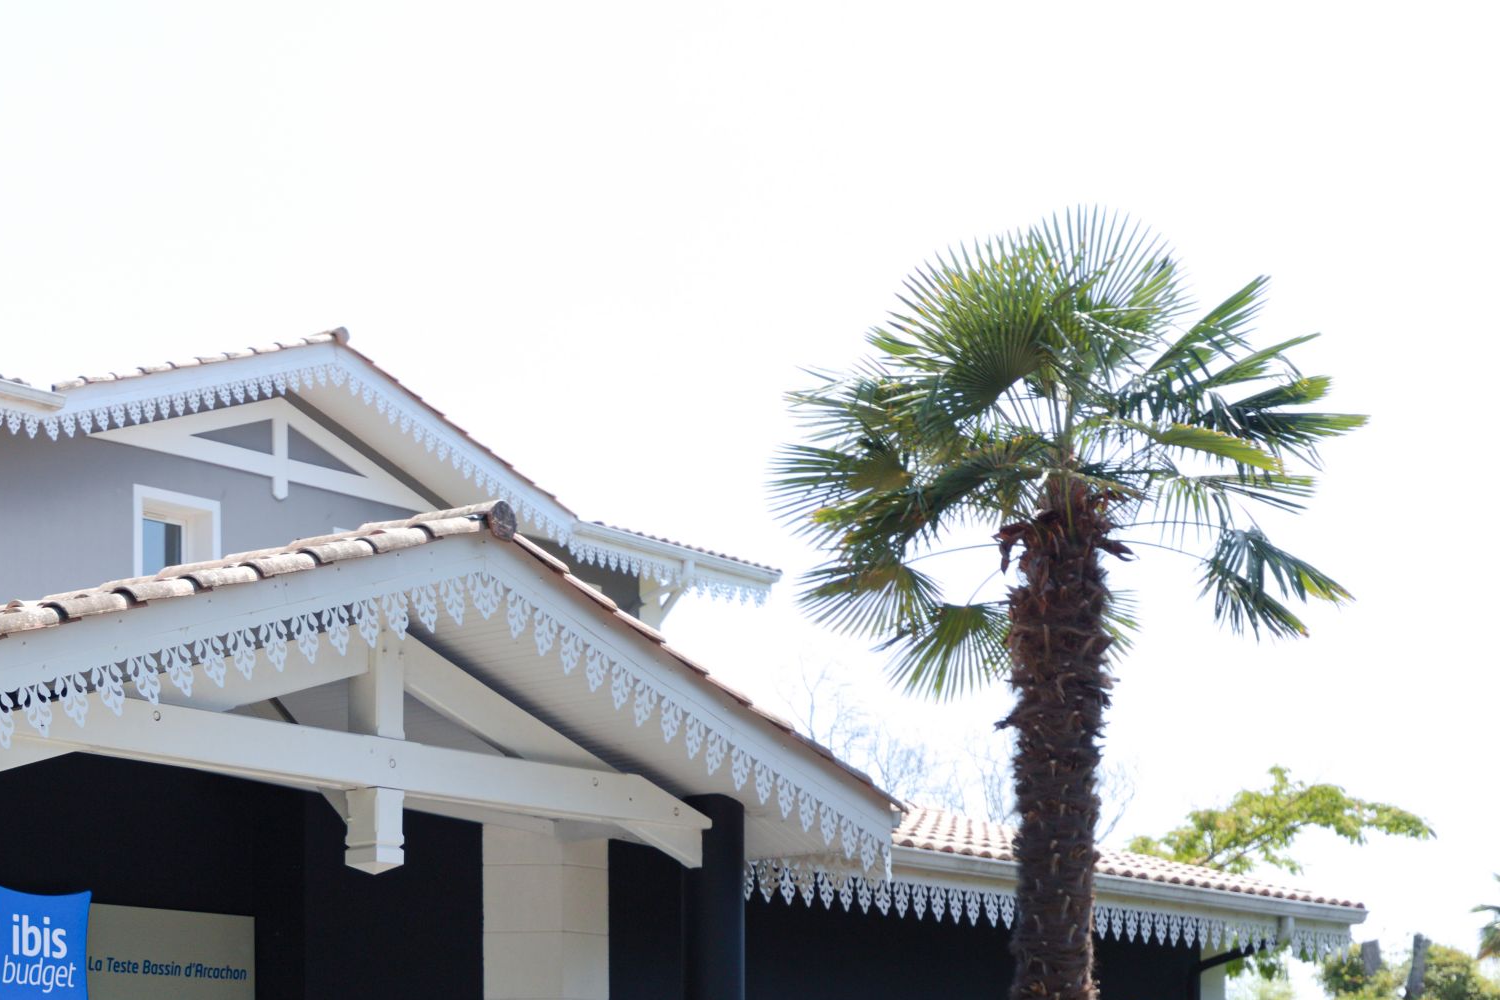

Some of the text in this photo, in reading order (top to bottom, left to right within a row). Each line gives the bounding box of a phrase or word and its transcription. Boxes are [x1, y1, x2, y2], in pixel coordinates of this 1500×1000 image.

[12, 914, 67, 959] ibis
[2, 954, 76, 993] budget
[88, 956, 247, 981] La Teste Bassin d'Arcachon
